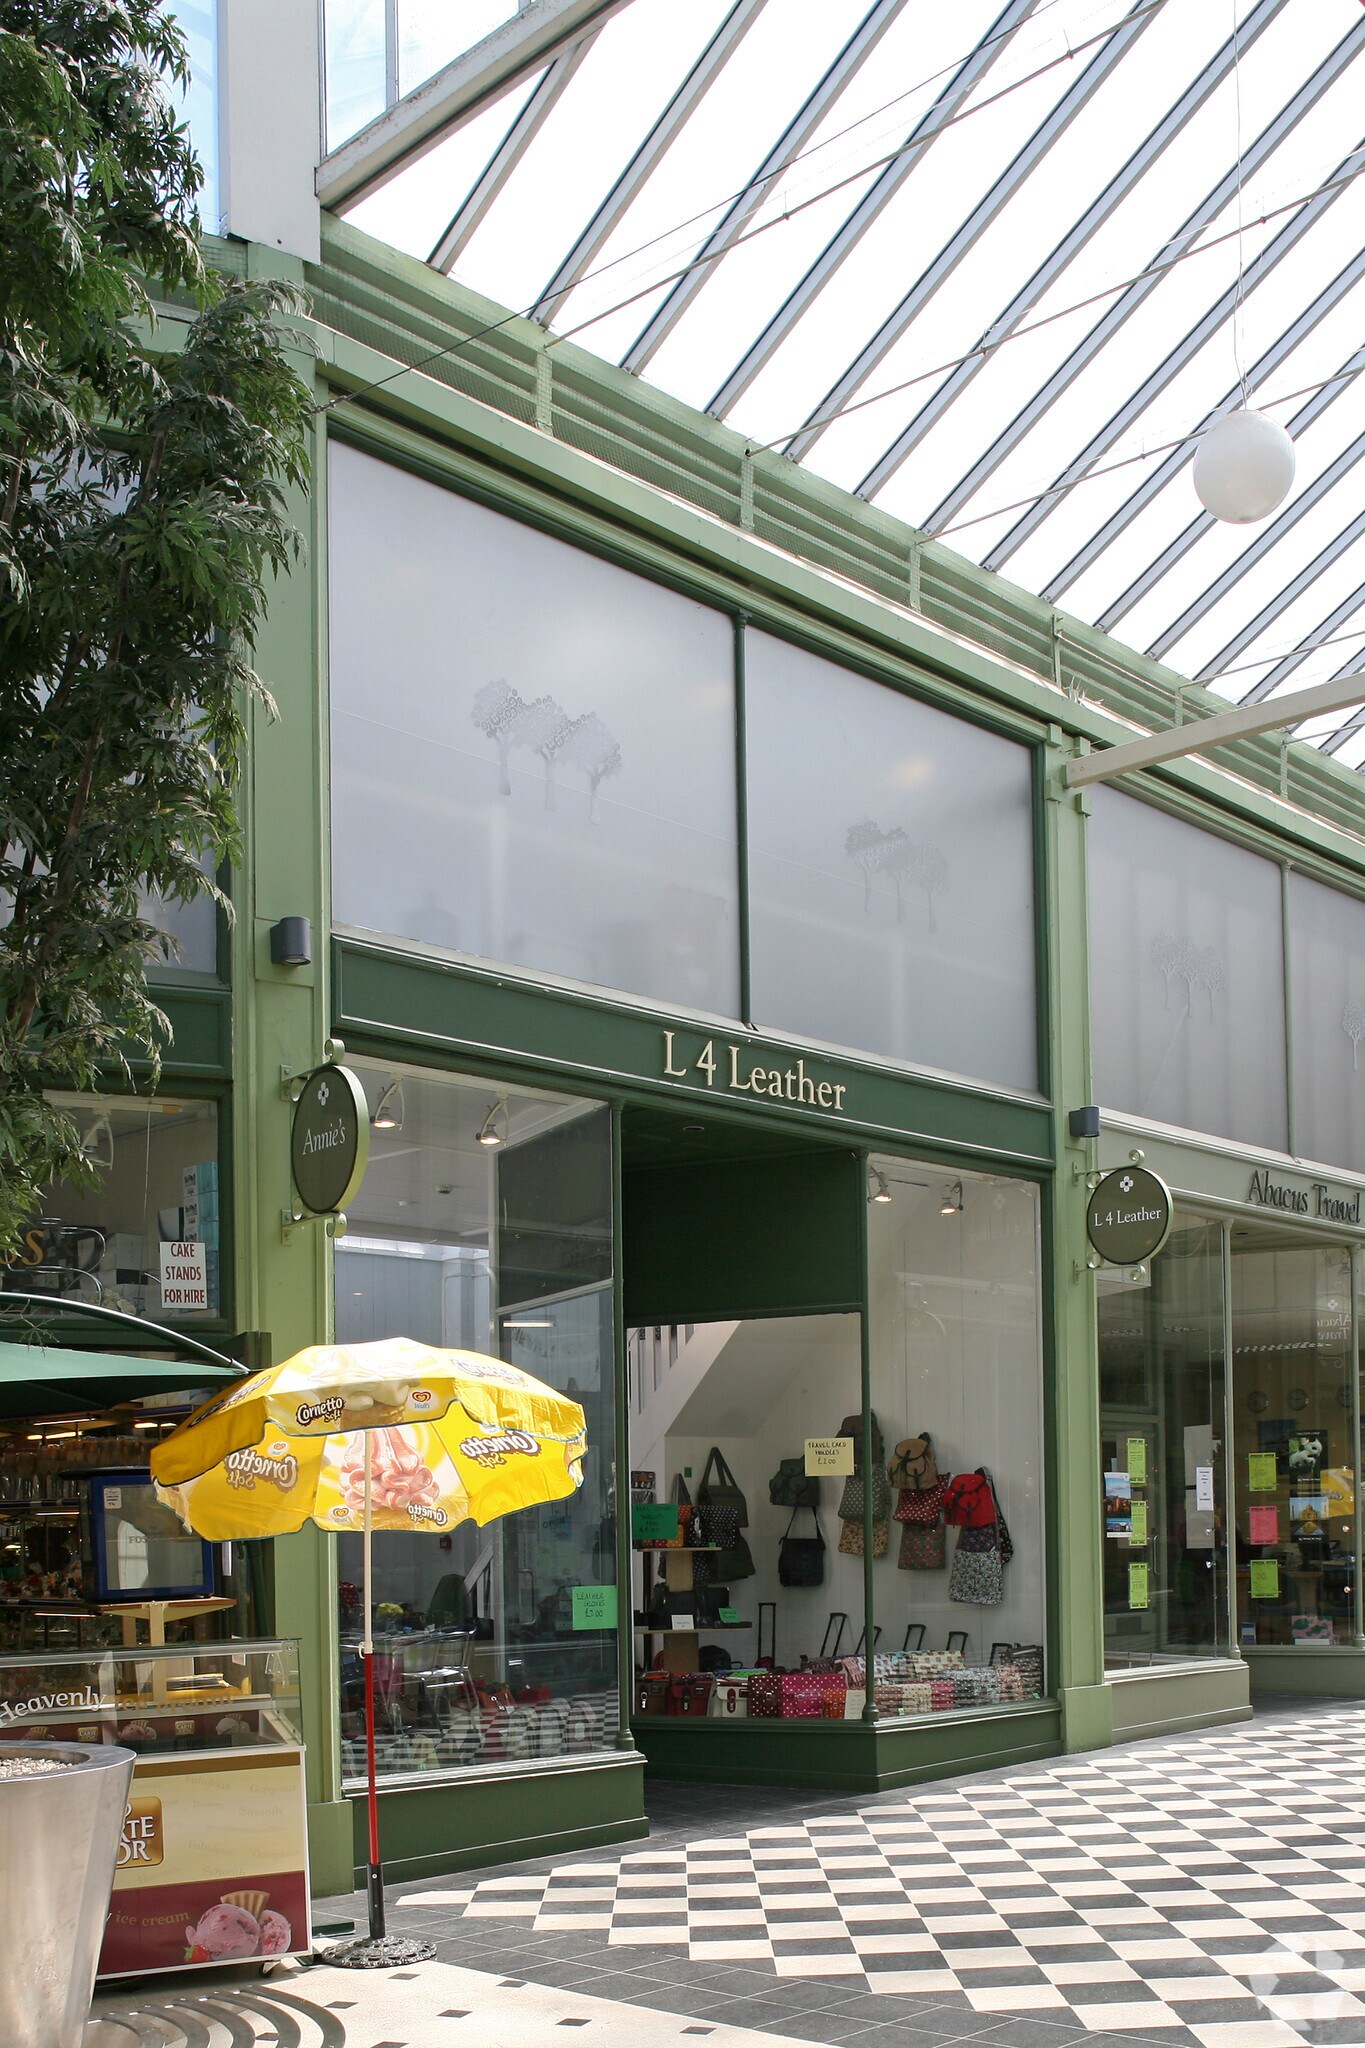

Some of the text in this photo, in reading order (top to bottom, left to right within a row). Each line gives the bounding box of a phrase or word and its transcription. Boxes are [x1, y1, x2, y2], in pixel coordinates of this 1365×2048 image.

[663, 1030, 846, 1111] L 4 Leather
[303, 1118, 346, 1155] Annie's
[1246, 1169, 1361, 1223] Abacus Travel
[1094, 1206, 1162, 1227] L 4 Leather
[171, 1243, 195, 1257] CAKE
[165, 1266, 201, 1280] STANDS
[164, 1289, 205, 1303] FOR HIRE
[297, 1397, 343, 1425] Cornetto
[0, 1685, 107, 1728] Heavenly
[116, 1910, 190, 1927] ice cream
